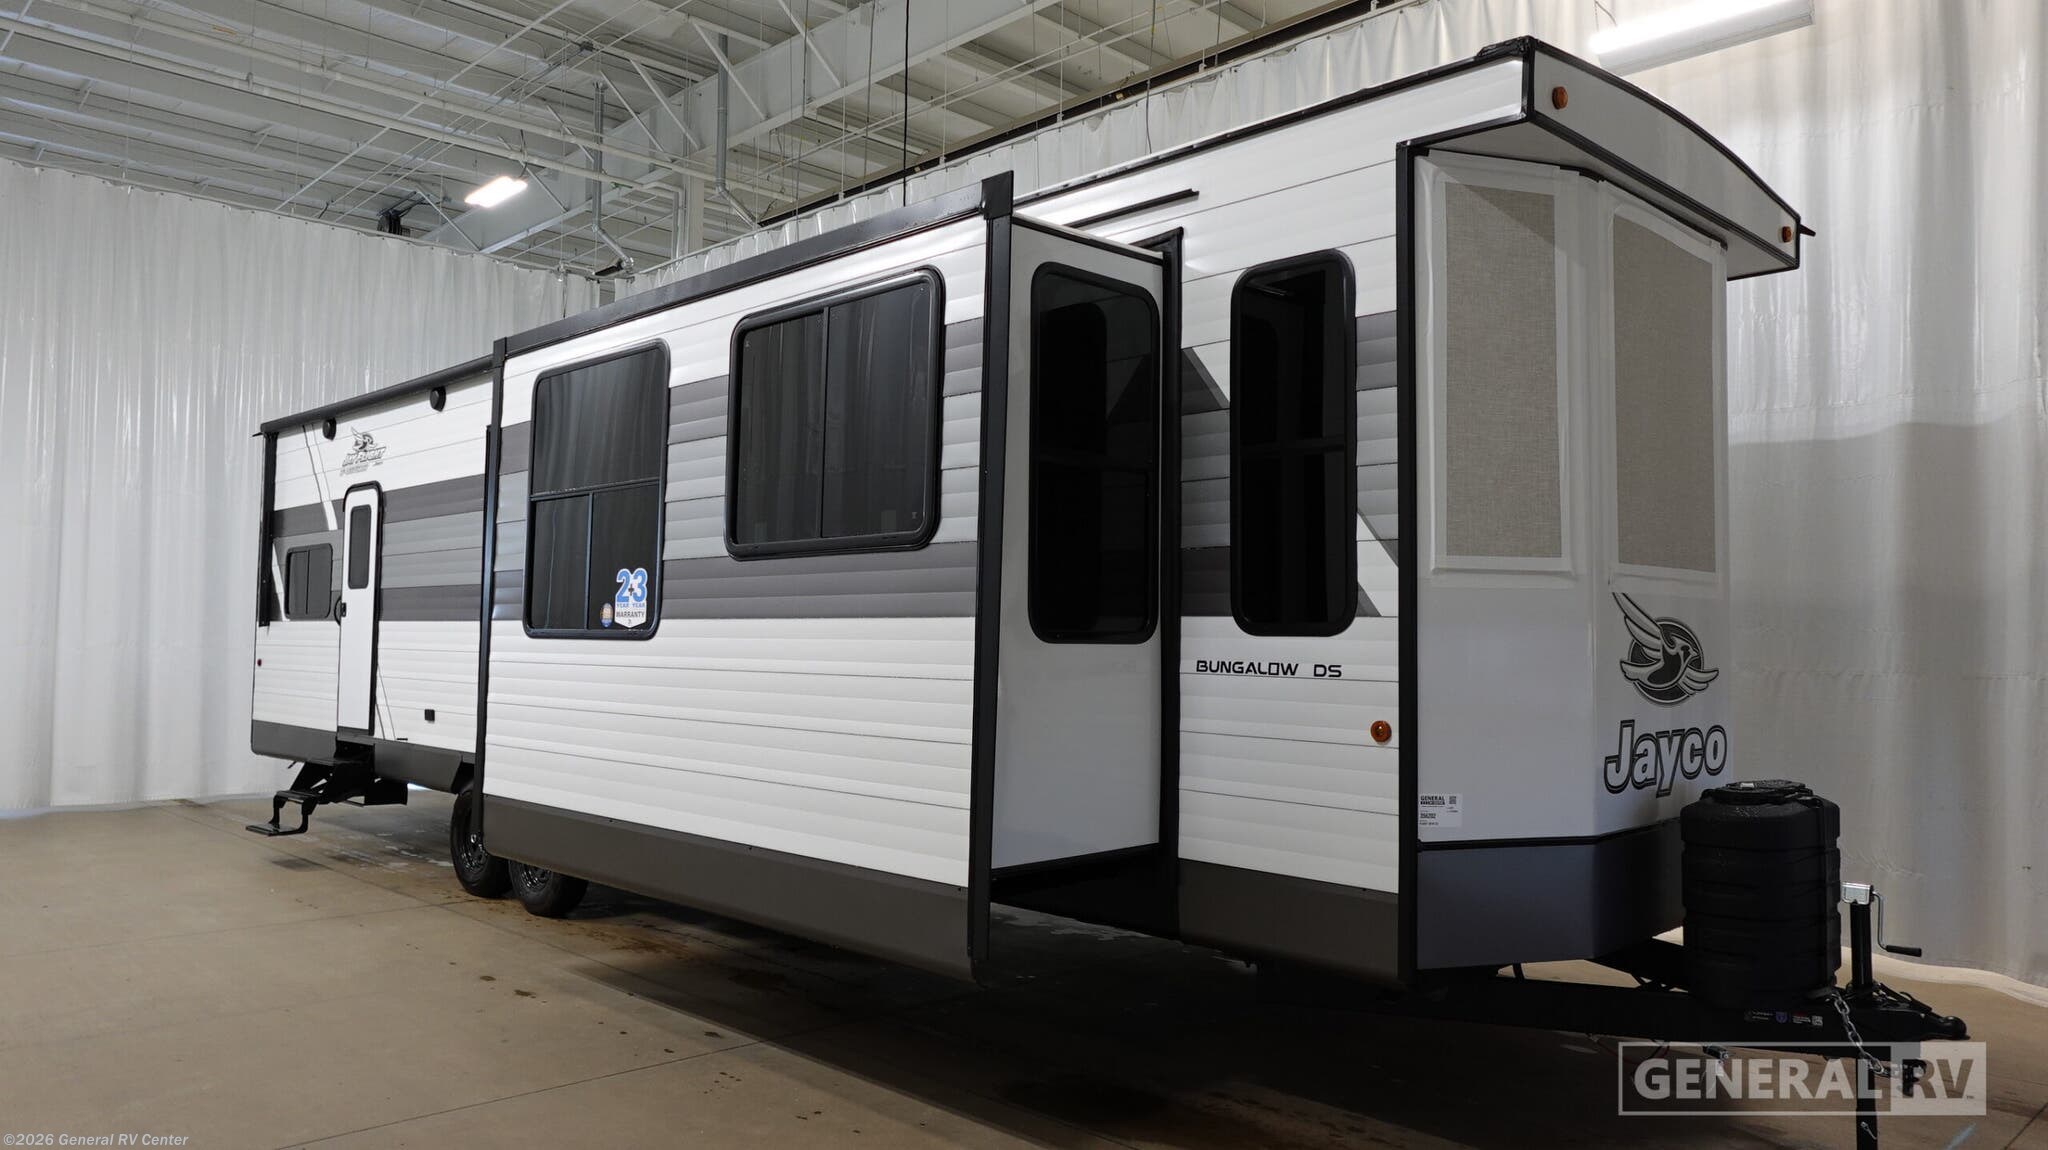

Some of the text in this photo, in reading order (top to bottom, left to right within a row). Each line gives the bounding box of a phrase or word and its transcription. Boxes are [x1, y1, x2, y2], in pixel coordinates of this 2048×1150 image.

[1196, 660, 1342, 678] BUNGALOW DS
[1604, 719, 1727, 798] Jayco
